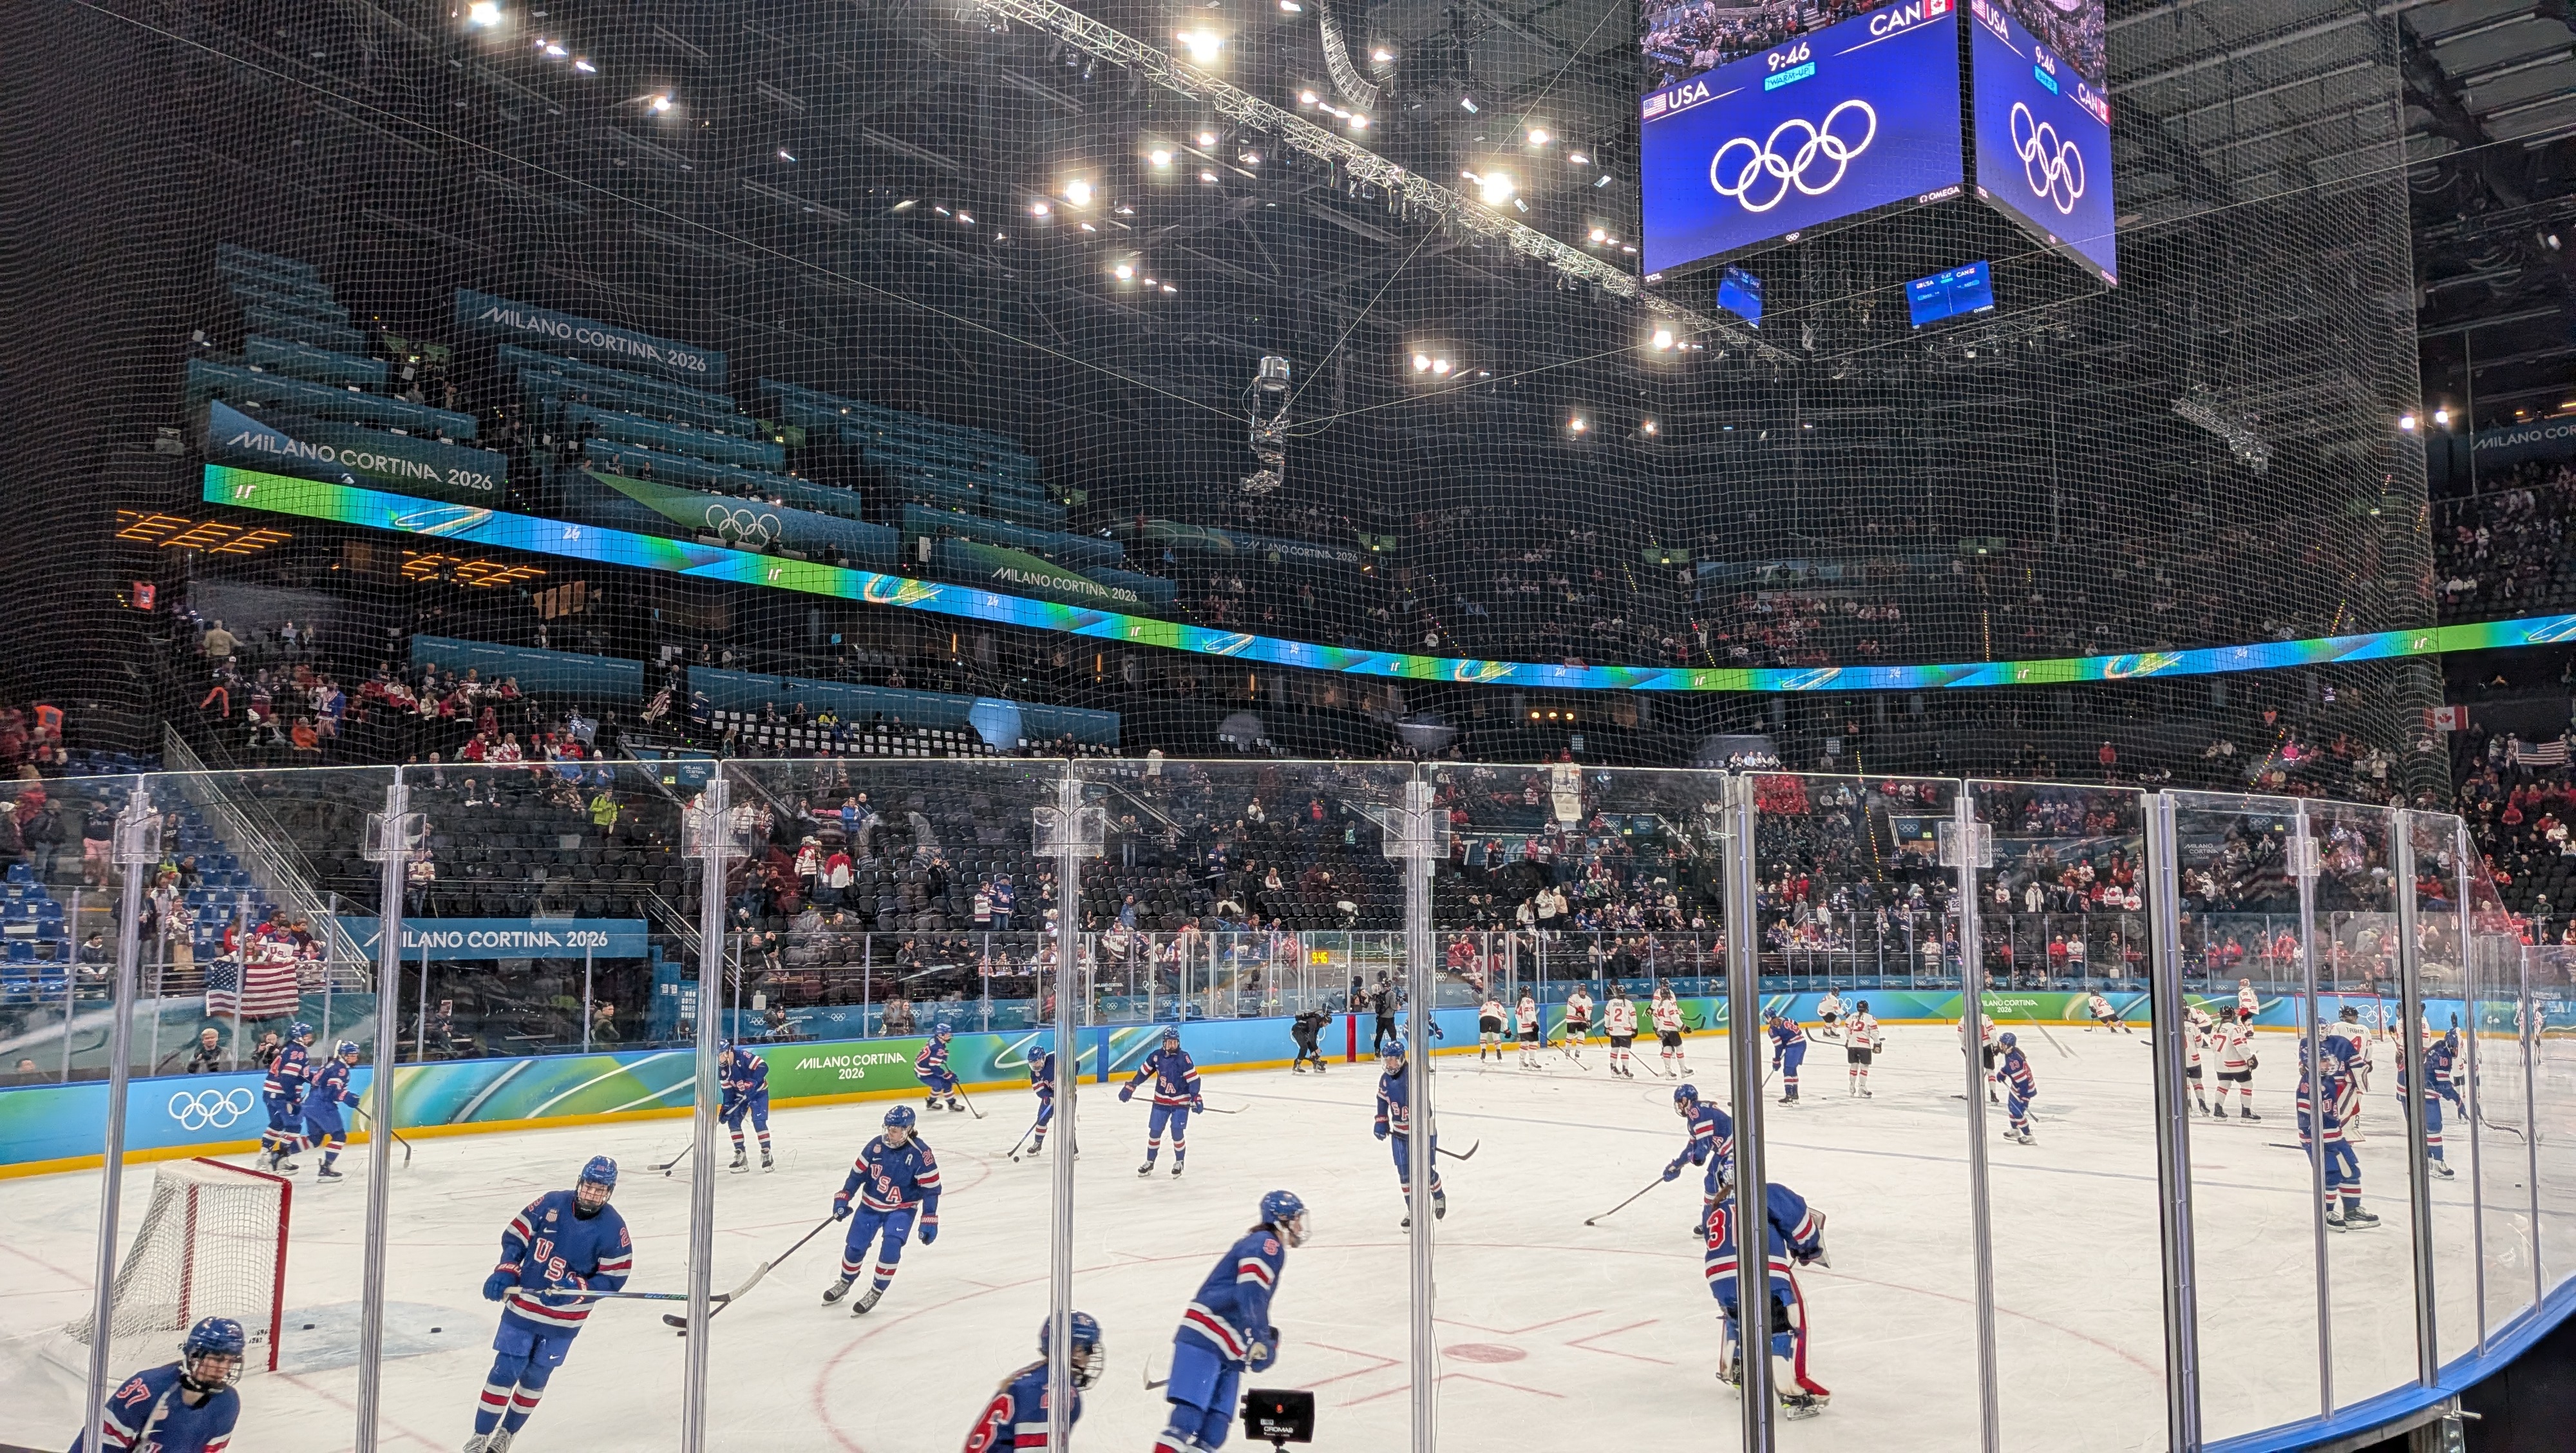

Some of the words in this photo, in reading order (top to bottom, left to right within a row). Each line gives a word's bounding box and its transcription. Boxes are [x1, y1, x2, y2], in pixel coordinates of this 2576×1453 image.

[1870, 3, 1920, 35] CAN
[1986, 4, 2009, 39] USA
[1768, 42, 1810, 71] 9:46
[2035, 46, 2055, 75] 9:46
[1768, 67, 1810, 88] WARM-UP
[1669, 81, 1710, 109] USA
[2078, 83, 2098, 113] CAN
[1929, 186, 1960, 200] OMEGA
[1978, 186, 1989, 198] TCL
[1645, 273, 1662, 282] TCL
[479, 307, 571, 339] MILANO
[576, 328, 663, 363] CORTINA
[668, 350, 706, 372] 2026
[2472, 430, 2542, 450] MILANO
[227, 431, 335, 462] MILANO
[341, 450, 443, 482] CORTINA
[448, 469, 493, 491] 2026
[1246, 542, 1288, 554] MANO
[1291, 546, 1333, 560] CORTINA
[1337, 552, 1358, 562] 2026
[991, 567, 1050, 587] MILANO
[1053, 578, 1110, 599] CORTINA
[1112, 588, 1137, 602] 2026
[468, 930, 562, 948] CORTINA
[567, 931, 608, 948] 2026
[1312, 951, 1328, 964] 9:46
[1614, 1008, 1622, 1021] 2
[795, 1056, 851, 1070] MILANO
[852, 1052, 907, 1066] CORTINA
[838, 1068, 865, 1079] 2026
[905, 1154, 913, 1166] A
[870, 1164, 902, 1203] USA
[116, 1378, 151, 1409] 37
